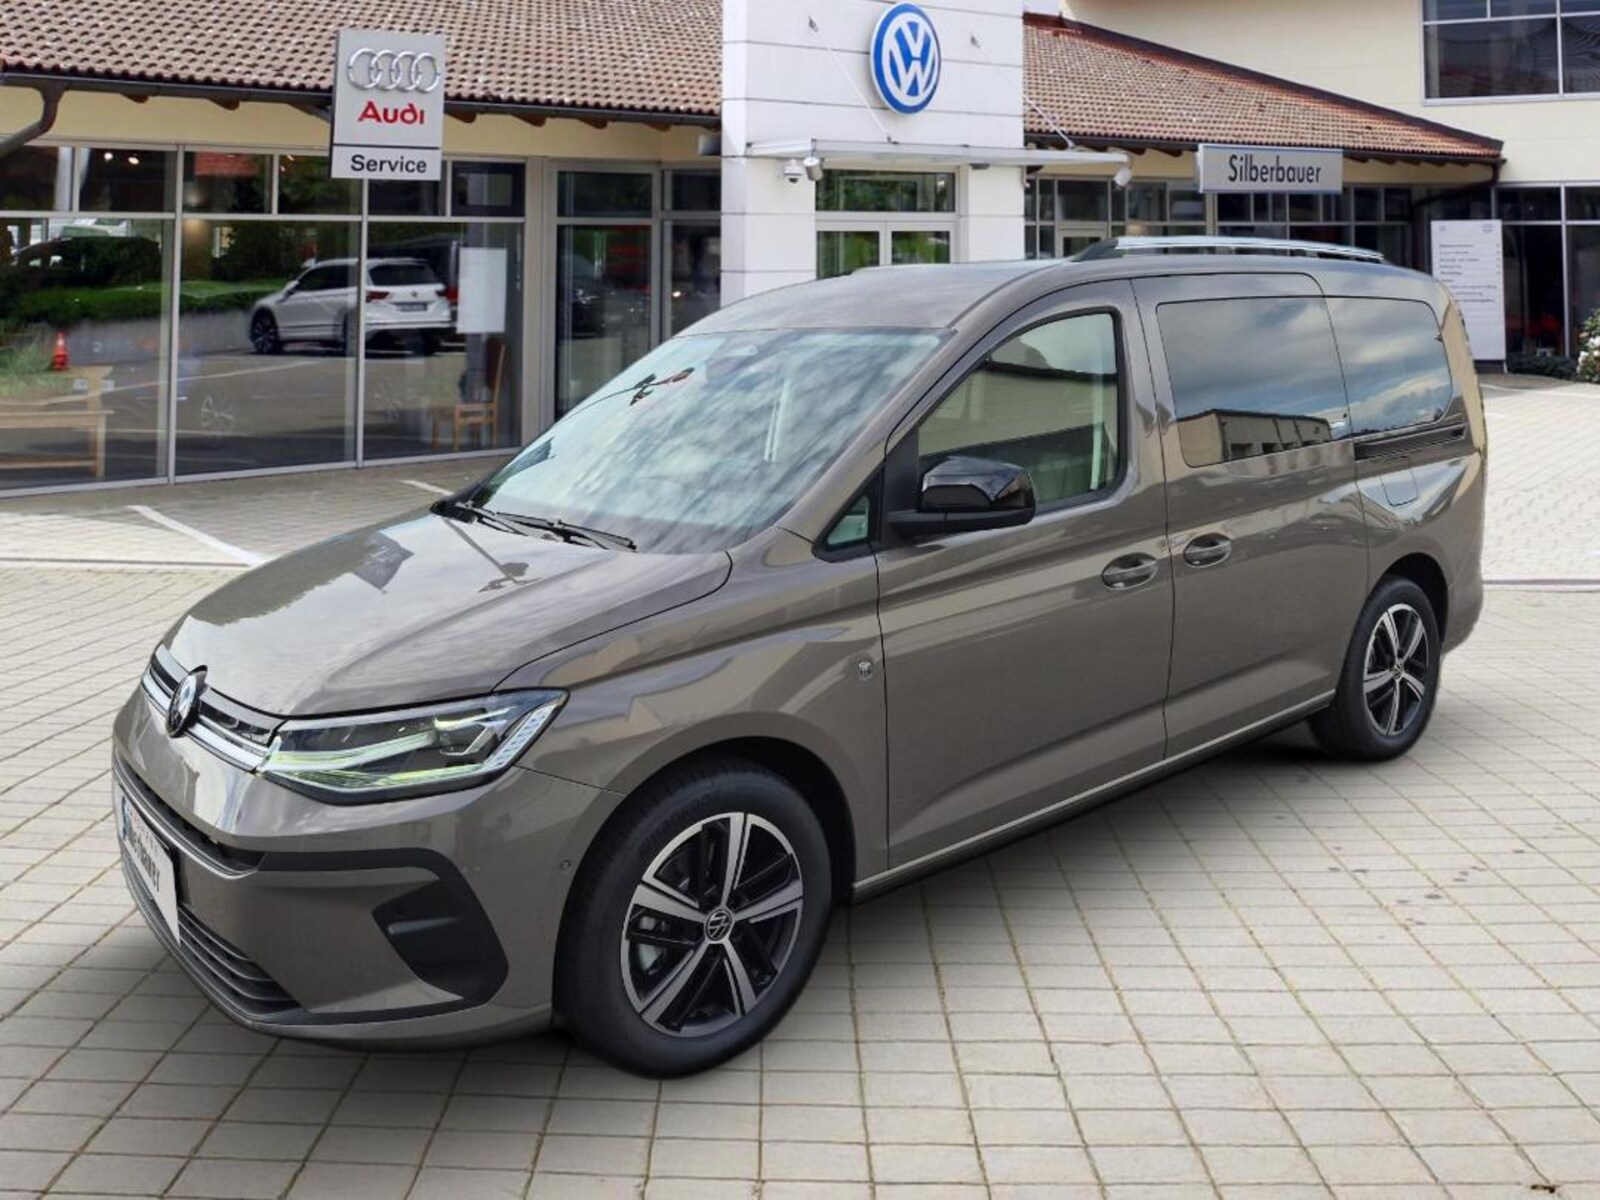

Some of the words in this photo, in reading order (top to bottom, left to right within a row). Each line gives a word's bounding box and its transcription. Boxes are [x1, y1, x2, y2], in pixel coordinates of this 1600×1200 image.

[357, 101, 425, 125] Audi
[351, 154, 427, 174] Service
[1228, 154, 1321, 183] Silberbauer
